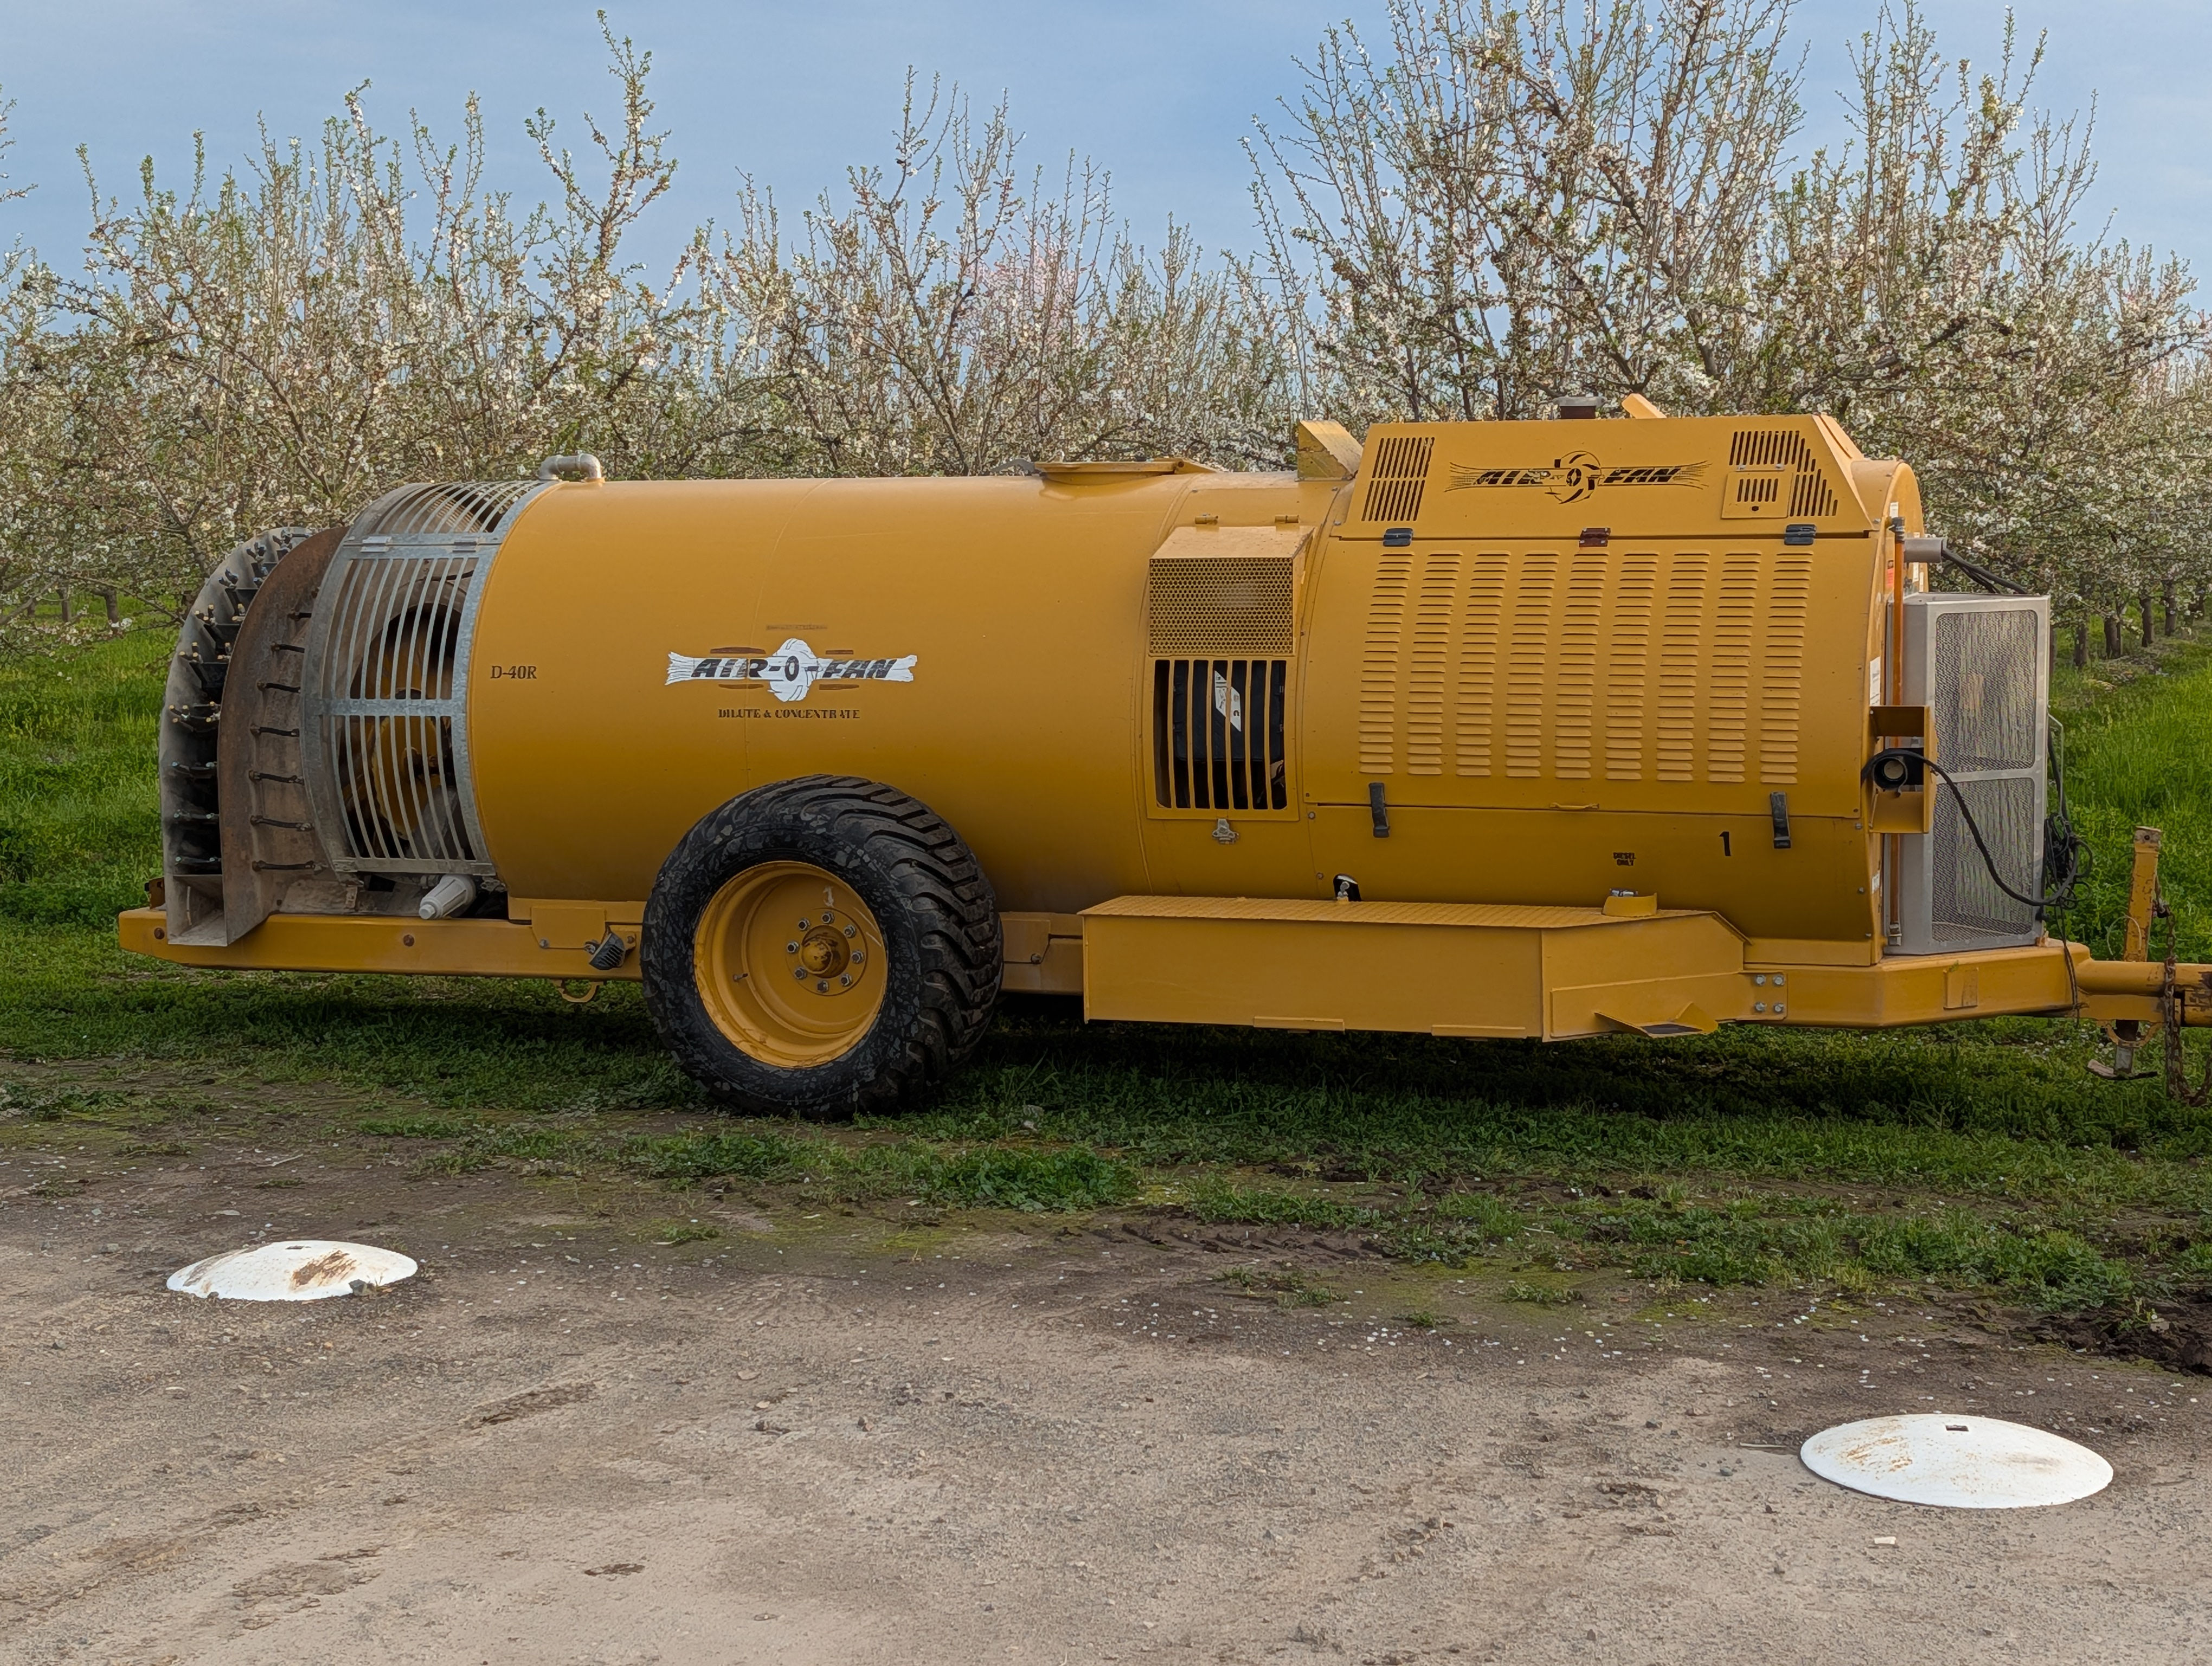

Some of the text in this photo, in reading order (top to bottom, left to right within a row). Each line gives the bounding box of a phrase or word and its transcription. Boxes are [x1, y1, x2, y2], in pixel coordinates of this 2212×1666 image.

[490, 665, 537, 678] D-40R
[718, 709, 761, 717] DILUTE
[1719, 831, 1731, 856] 1
